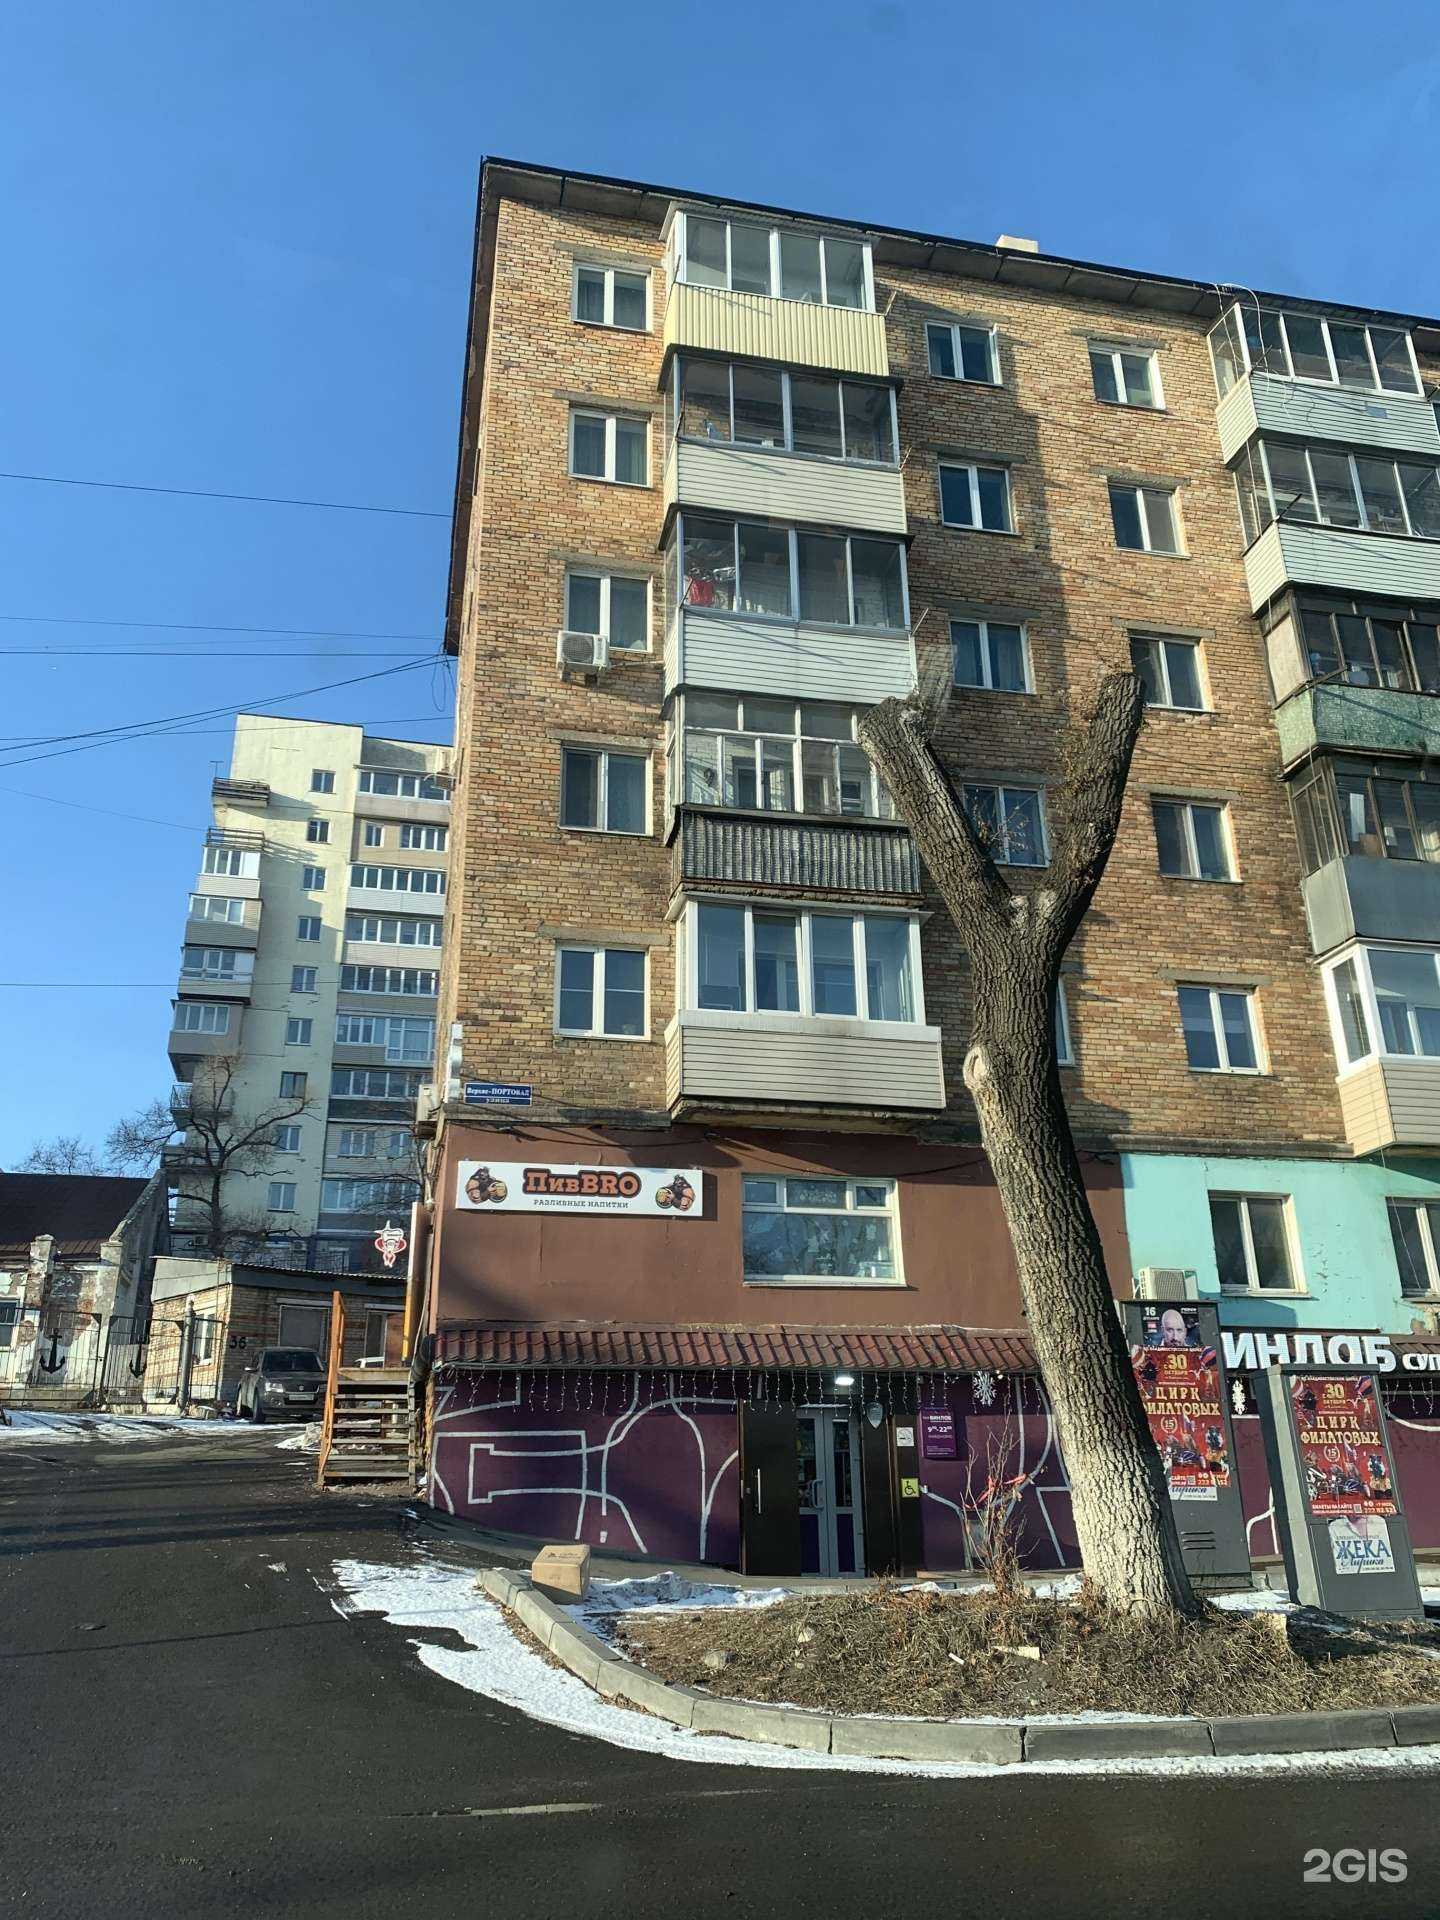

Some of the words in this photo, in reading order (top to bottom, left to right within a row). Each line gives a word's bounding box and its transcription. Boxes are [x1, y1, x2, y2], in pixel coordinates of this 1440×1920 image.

[533, 1199, 586, 1208] РАЗЛИВНЫЕ
[588, 1200, 629, 1209] НАПИТКИ
[1144, 1307, 1157, 1316] 16
[1221, 1332, 1397, 1373] ИНЛАБ
[1168, 1354, 1188, 1369] 30
[1155, 1387, 1200, 1401] ЦИРК
[1325, 1383, 1345, 1399] 30
[1315, 1416, 1361, 1430] ЦИРК
[1300, 1431, 1381, 1446] ФИЛАТОВЫХ
[1327, 1447, 1337, 1457] 15
[1334, 1540, 1391, 1559] ЖЕКА
